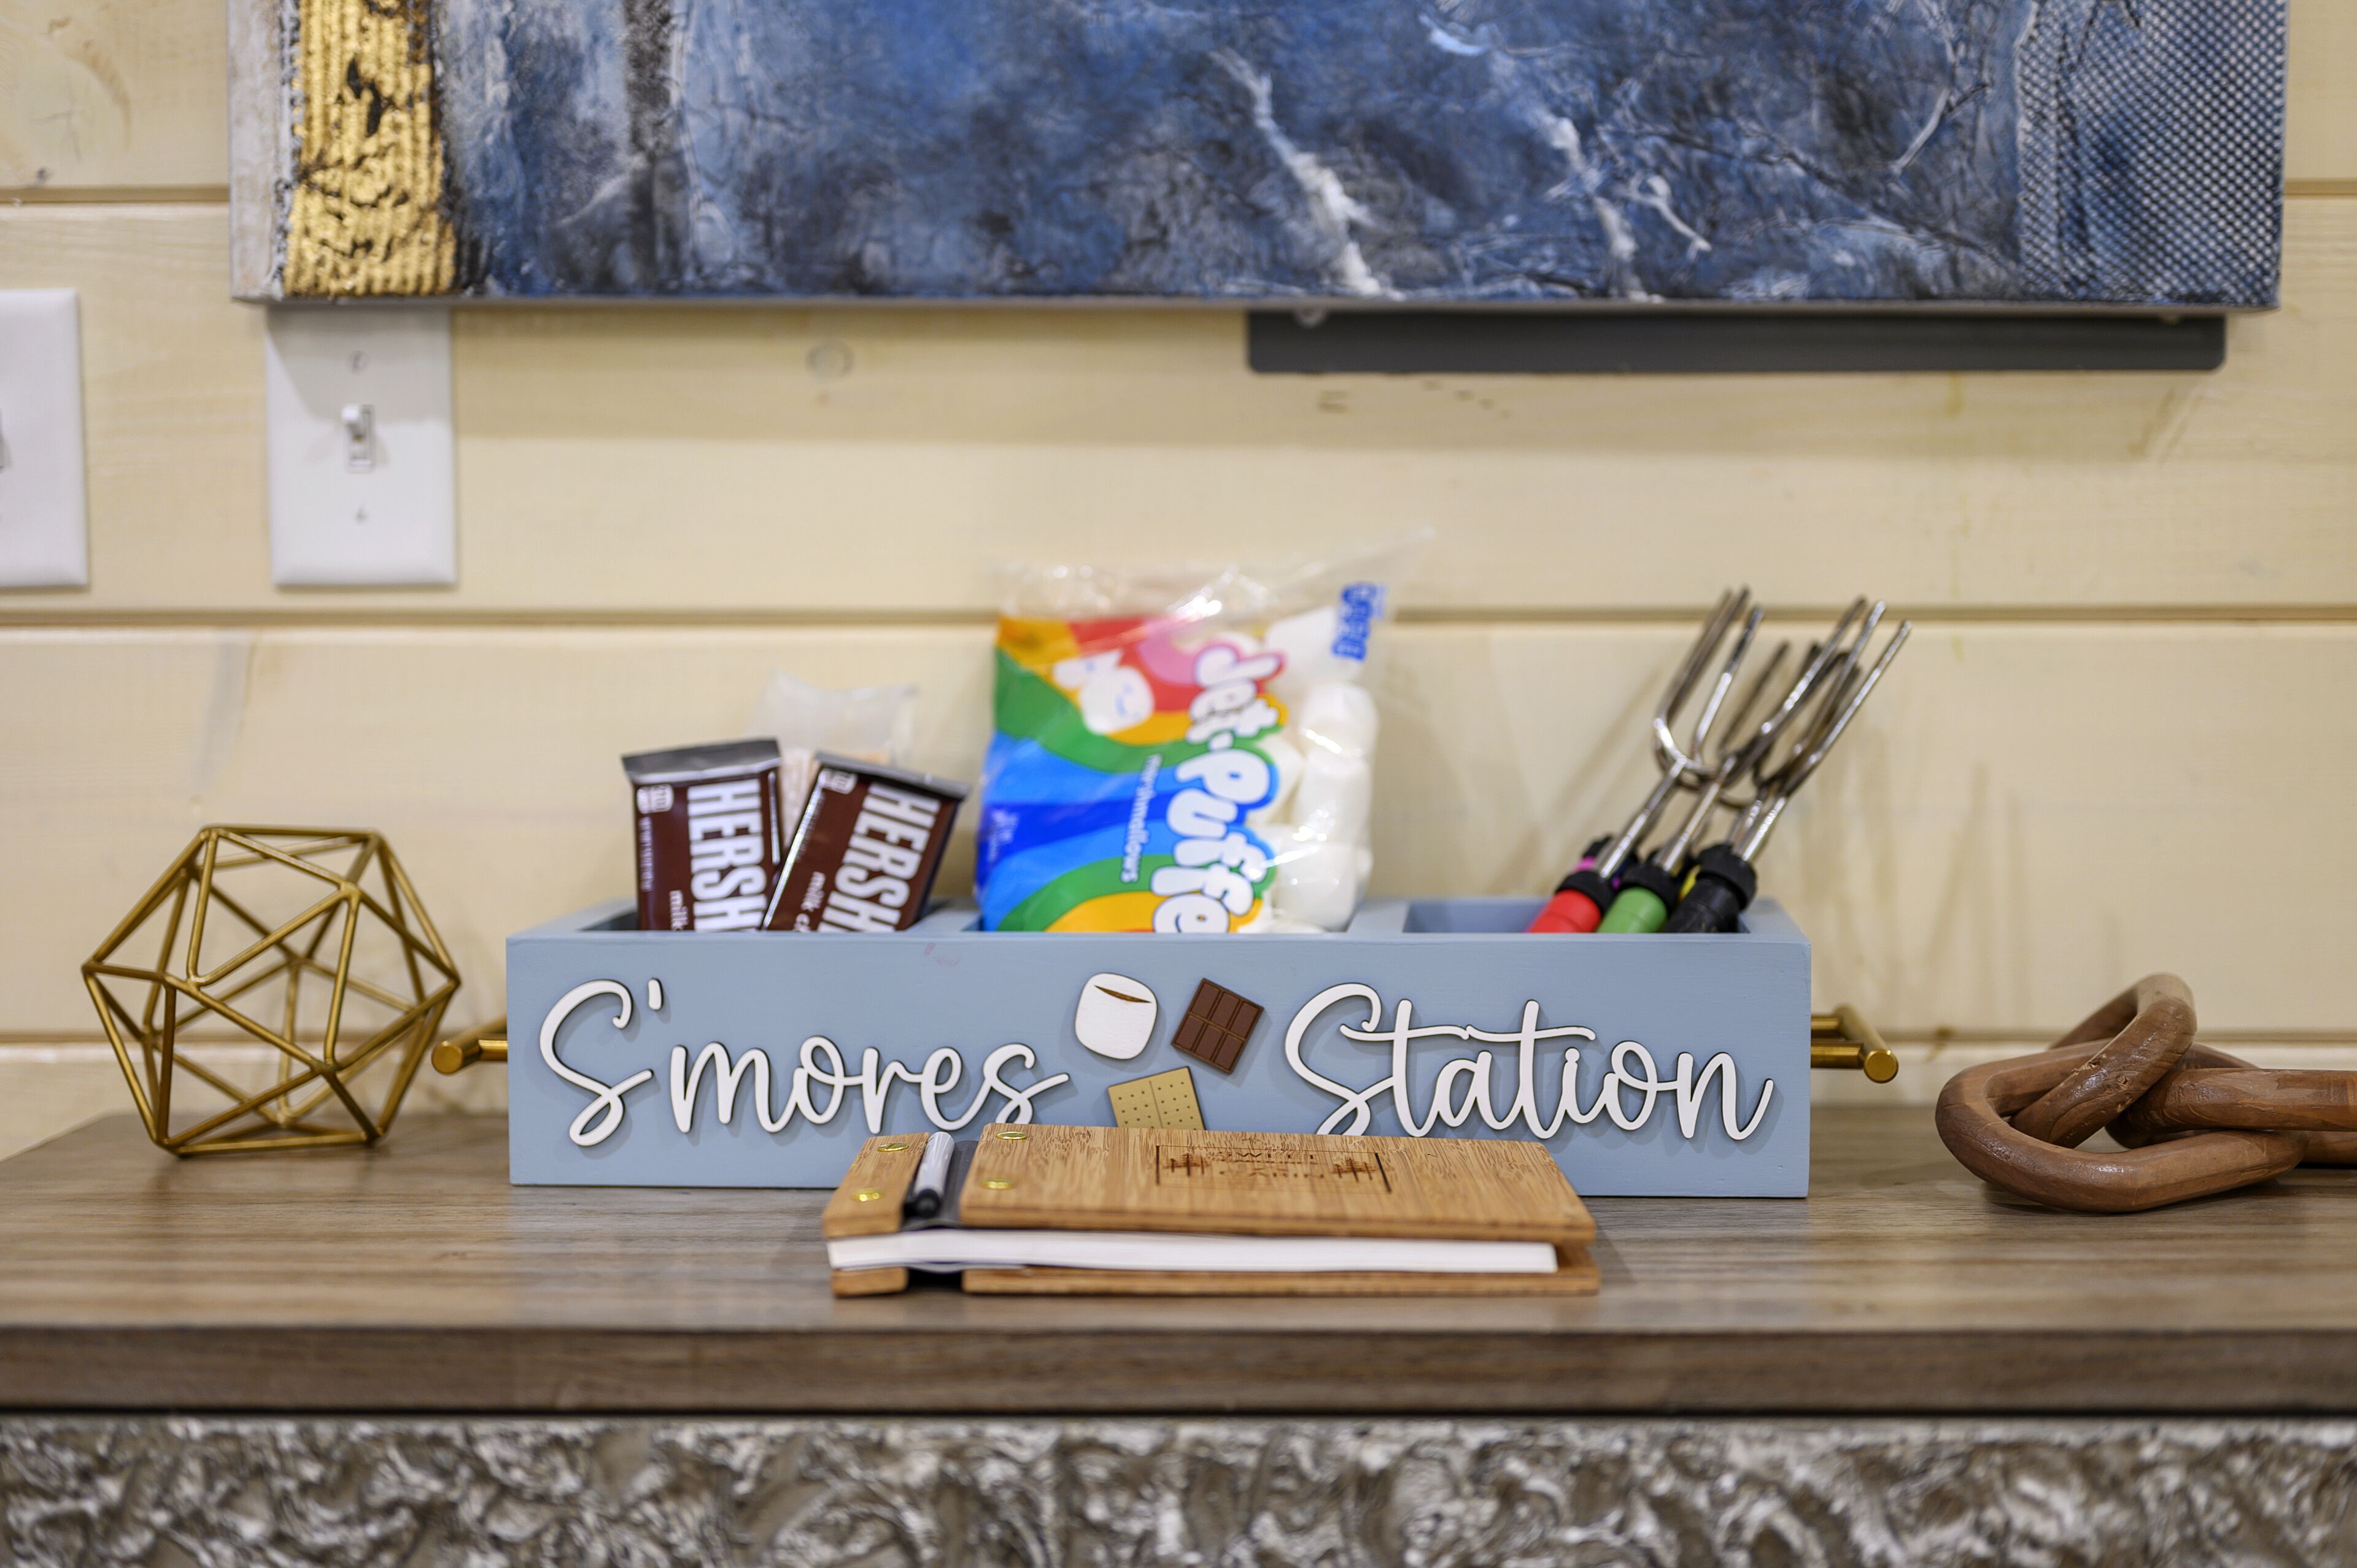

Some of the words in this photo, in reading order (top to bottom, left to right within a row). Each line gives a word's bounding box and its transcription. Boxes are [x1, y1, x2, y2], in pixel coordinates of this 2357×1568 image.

[817, 781, 941, 931] HERSH
[1121, 753, 1162, 882] marshmallows
[802, 871, 826, 911] milk
[540, 978, 1070, 1146] S'mores
[1284, 982, 1775, 1141] Station
